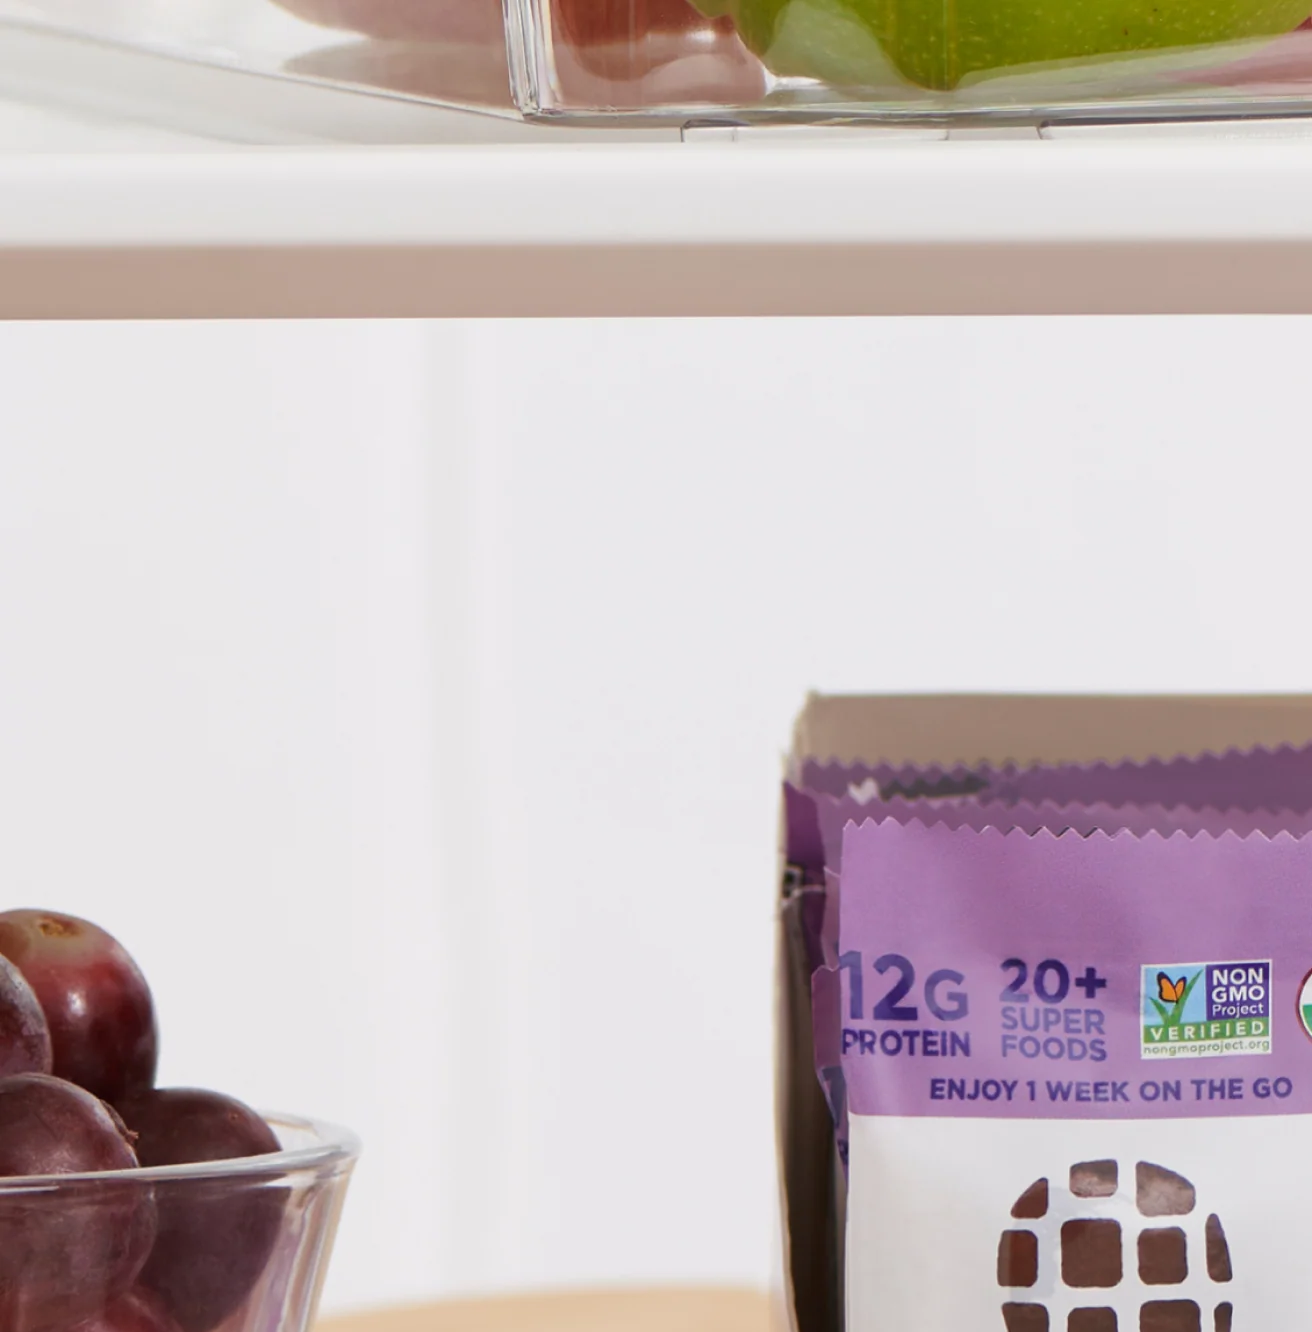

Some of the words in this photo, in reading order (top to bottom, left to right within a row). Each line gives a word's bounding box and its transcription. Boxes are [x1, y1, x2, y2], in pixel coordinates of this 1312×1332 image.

[839, 950, 969, 1022] 12G
[1000, 957, 1107, 1004] 20+
[1212, 968, 1264, 986] NON
[1211, 986, 1265, 1003] GMO
[1001, 1006, 1106, 1035] SUPER
[1213, 1003, 1264, 1018] Project
[841, 1029, 971, 1057] PROTEIN
[1150, 1021, 1265, 1041] VERIFIED
[1001, 1035, 1107, 1062] FOODS
[1144, 1039, 1270, 1057] nongmoproject.org
[930, 1078, 1018, 1101] ENJOY
[1025, 1080, 1037, 1101] 1
[1046, 1080, 1130, 1102] WEEK
[1139, 1080, 1182, 1101] ON
[1191, 1078, 1244, 1101] THE
[1252, 1077, 1293, 1099] GO
